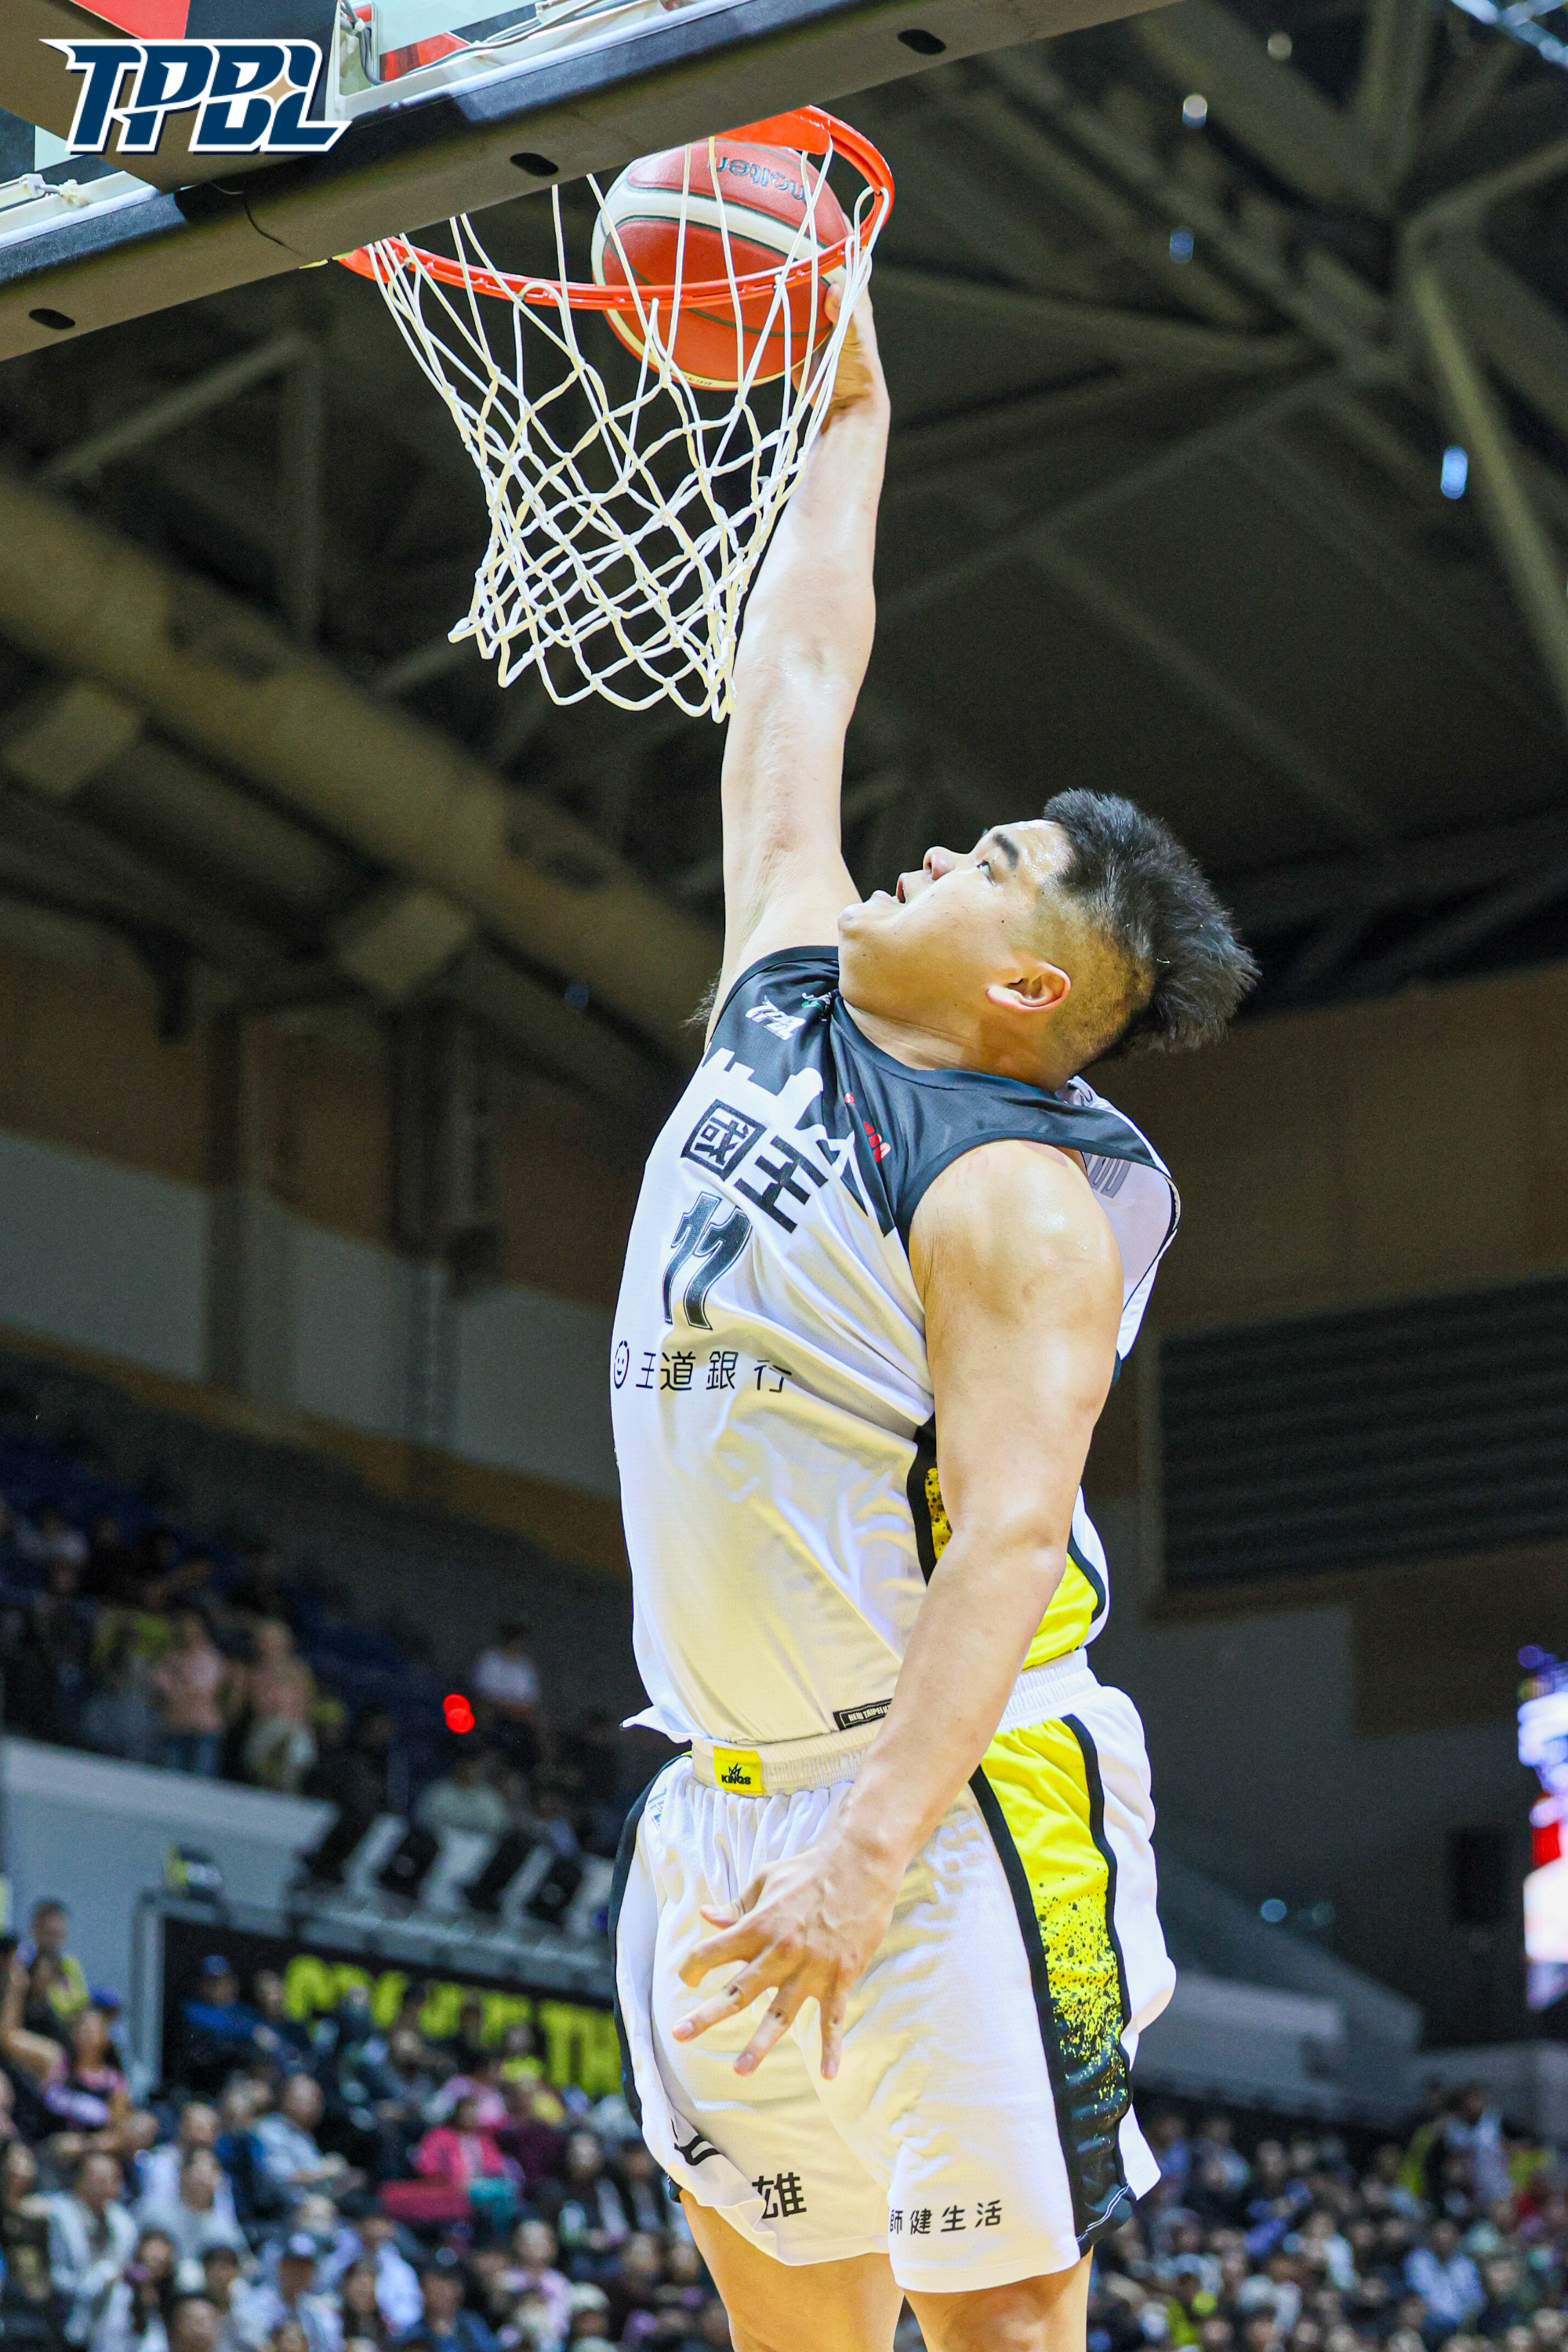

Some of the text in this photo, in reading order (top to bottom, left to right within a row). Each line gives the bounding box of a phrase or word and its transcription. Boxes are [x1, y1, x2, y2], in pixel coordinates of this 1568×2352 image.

[681, 1098, 829, 1234] 國王
[662, 1191, 753, 1330] 11
[636, 1351, 792, 1392] 王道銀行
[848, 1711, 864, 1722] NEW
[863, 1706, 884, 1719] TAIPEI
[721, 1774, 751, 1785] KINGS
[889, 2199, 1003, 2235] 師健生活
